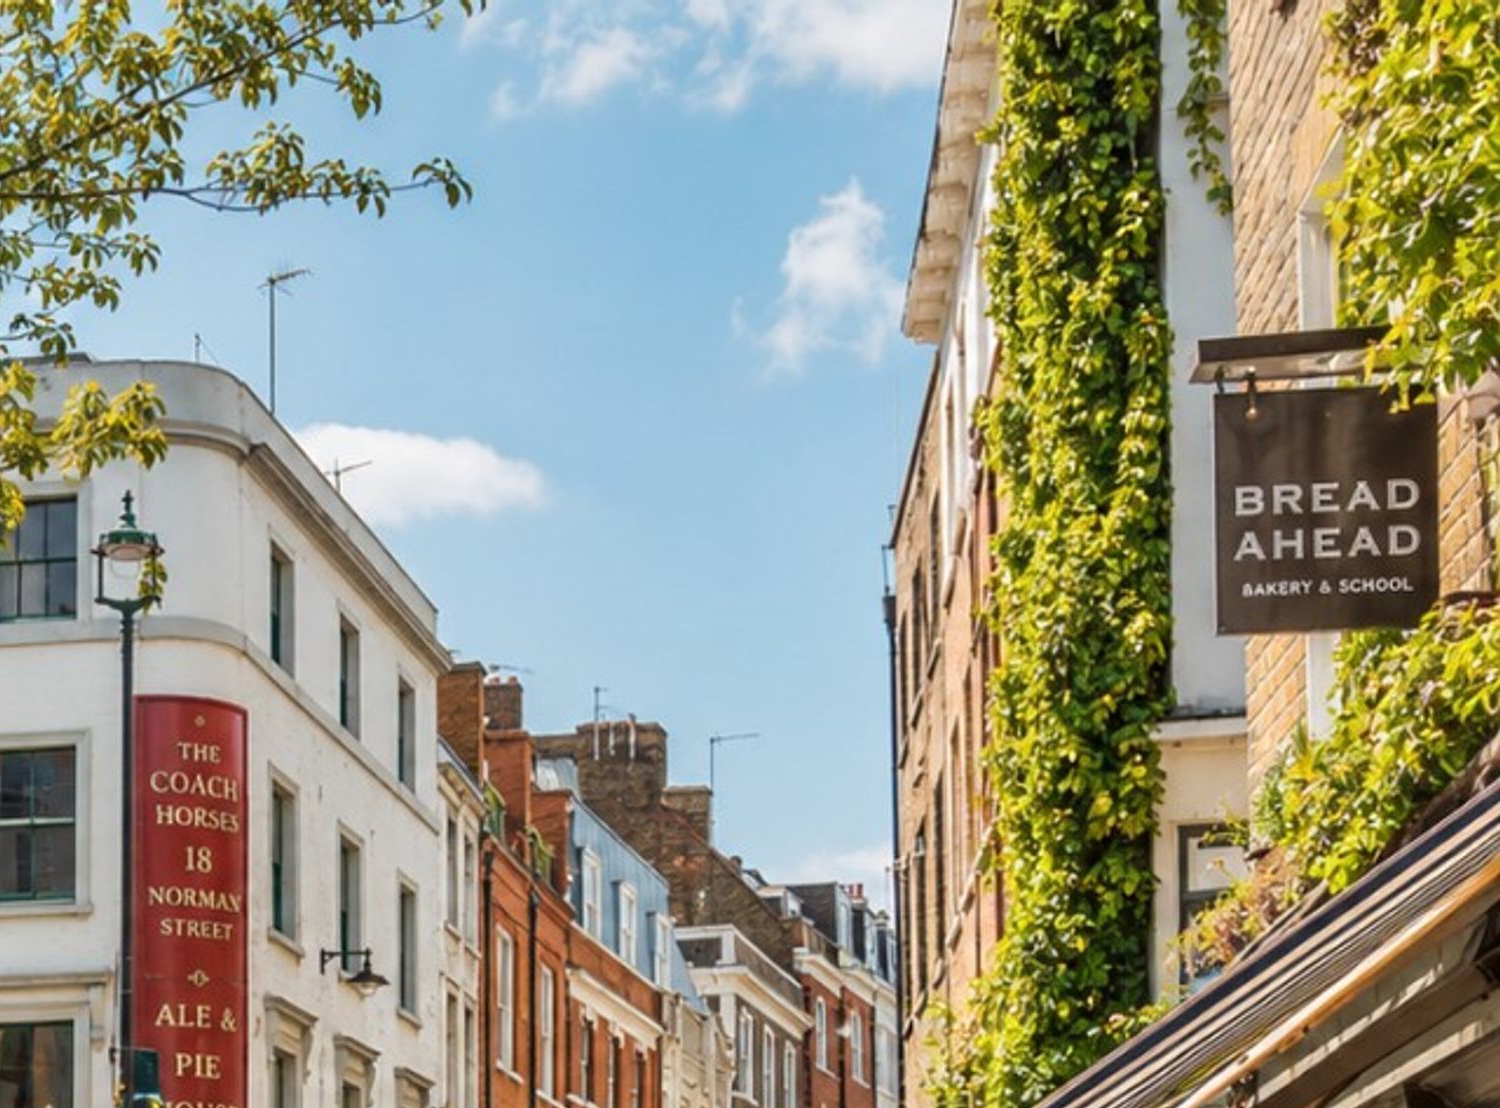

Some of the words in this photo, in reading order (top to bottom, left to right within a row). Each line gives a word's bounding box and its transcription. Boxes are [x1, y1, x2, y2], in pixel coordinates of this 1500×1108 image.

[1234, 478, 1420, 516] BREAD
[1233, 524, 1421, 562] AHEAD
[1242, 579, 1313, 597] BAKERY
[1319, 580, 1331, 594] &
[1338, 576, 1414, 593] SCHOOL
[177, 741, 221, 764] THE
[150, 770, 238, 802] COACH
[156, 804, 239, 834] HORSES
[186, 846, 212, 873] 18
[160, 918, 233, 940] STREET
[154, 1003, 212, 1029] ALE
[221, 1007, 237, 1032] &
[175, 1052, 221, 1079] PIE
